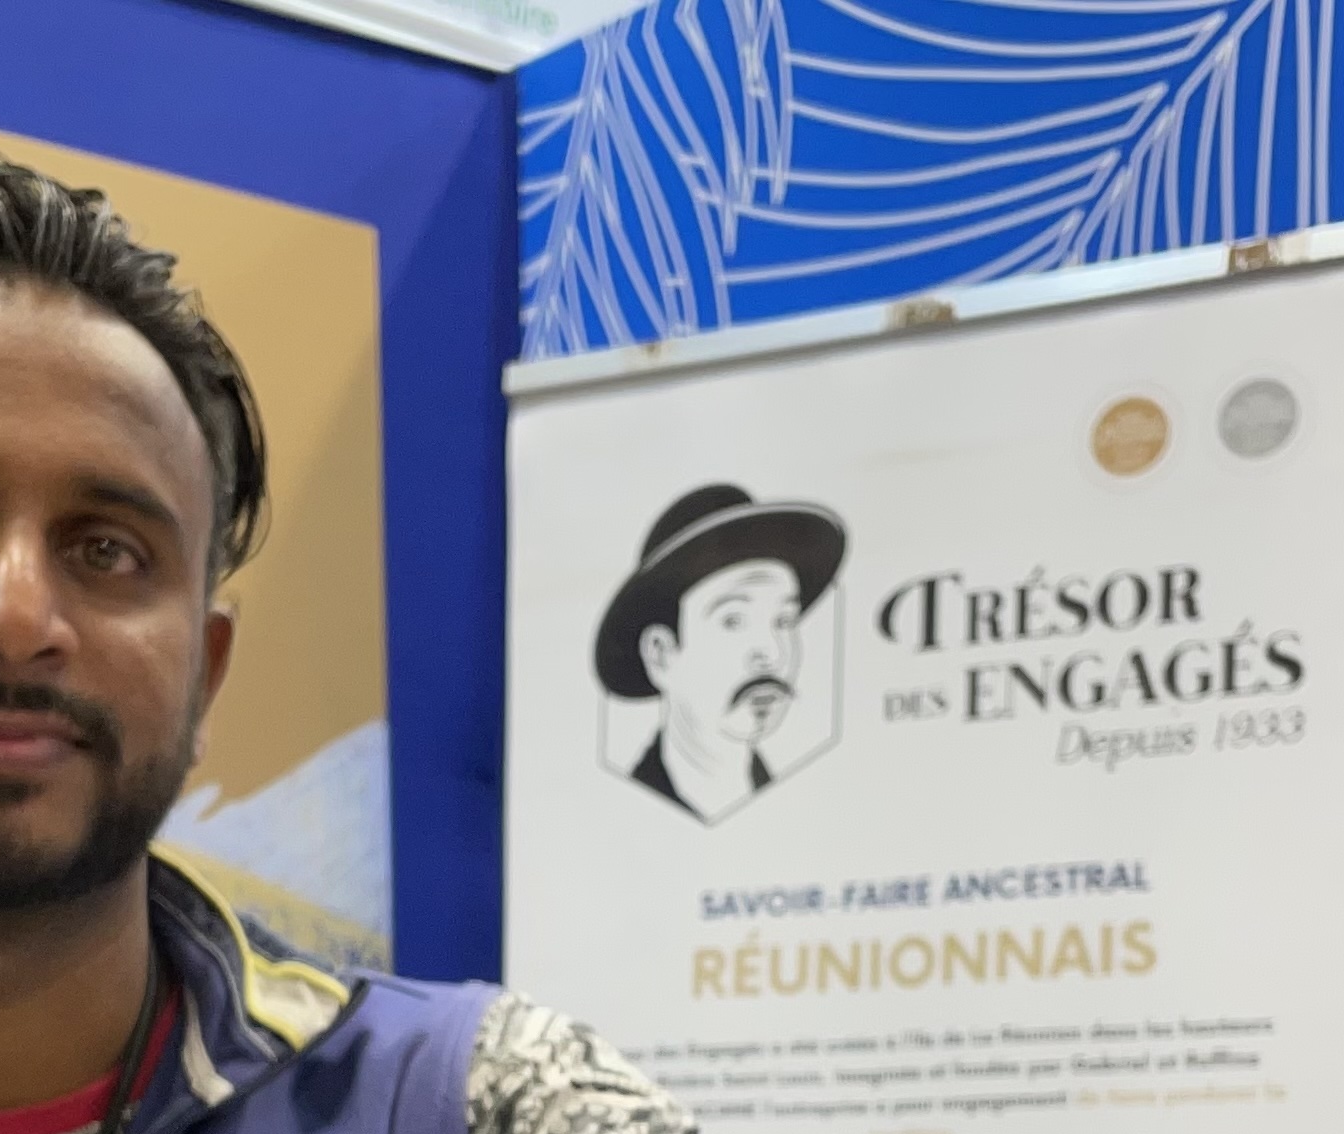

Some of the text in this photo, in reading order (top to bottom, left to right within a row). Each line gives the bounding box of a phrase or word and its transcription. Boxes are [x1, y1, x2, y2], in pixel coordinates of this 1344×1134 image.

[873, 564, 1203, 652] TRÉSOR
[882, 618, 1306, 723] DES ENGAGÉS
[1055, 705, 1308, 774] Depuis 1933
[699, 858, 1151, 922] SAVOIR-FAIRE ANCESTRAL
[690, 918, 1157, 998] RÉUNIONNAIS
